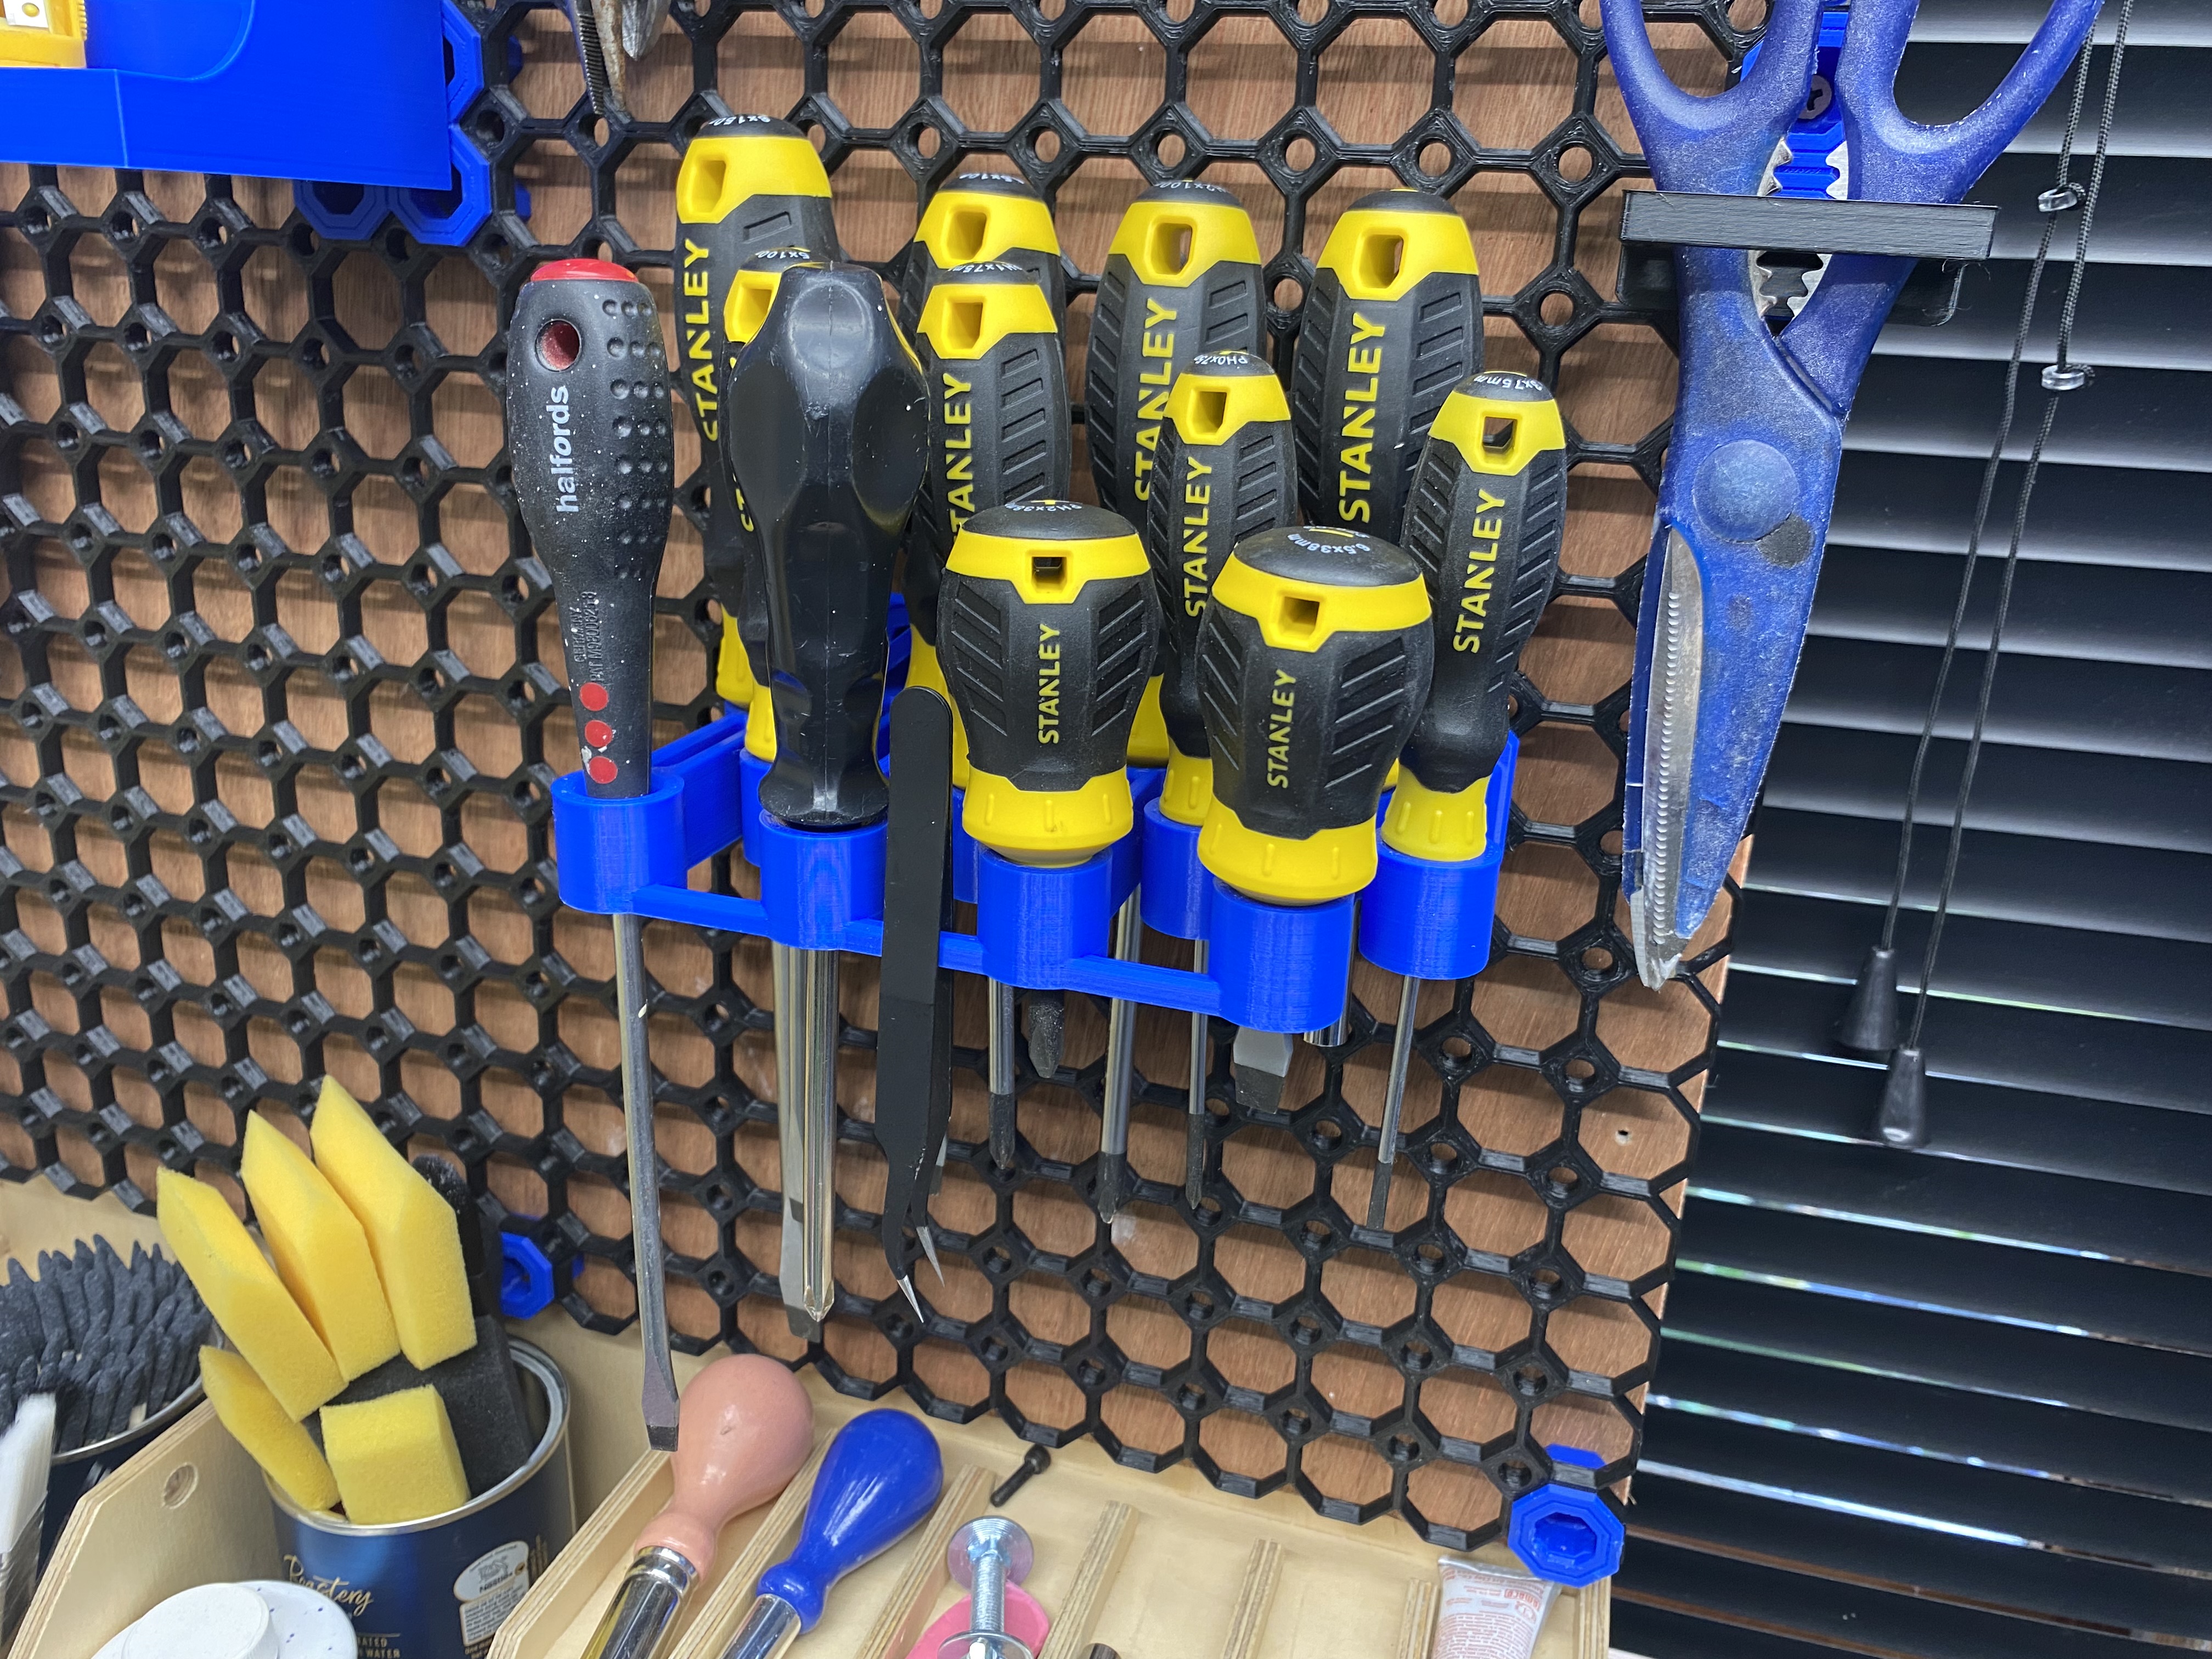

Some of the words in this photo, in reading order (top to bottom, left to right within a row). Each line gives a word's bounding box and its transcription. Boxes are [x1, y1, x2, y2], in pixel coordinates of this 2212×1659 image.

[546, 385, 579, 512] halfords
[1339, 312, 1385, 523] STANLEY
[1183, 456, 1212, 617] STANLEY
[1288, 533, 1371, 555] 6.5x38mm
[1453, 489, 1505, 653] STANLEY
[1038, 623, 1060, 744] STANLEY
[1266, 669, 1296, 789] STANLEY
